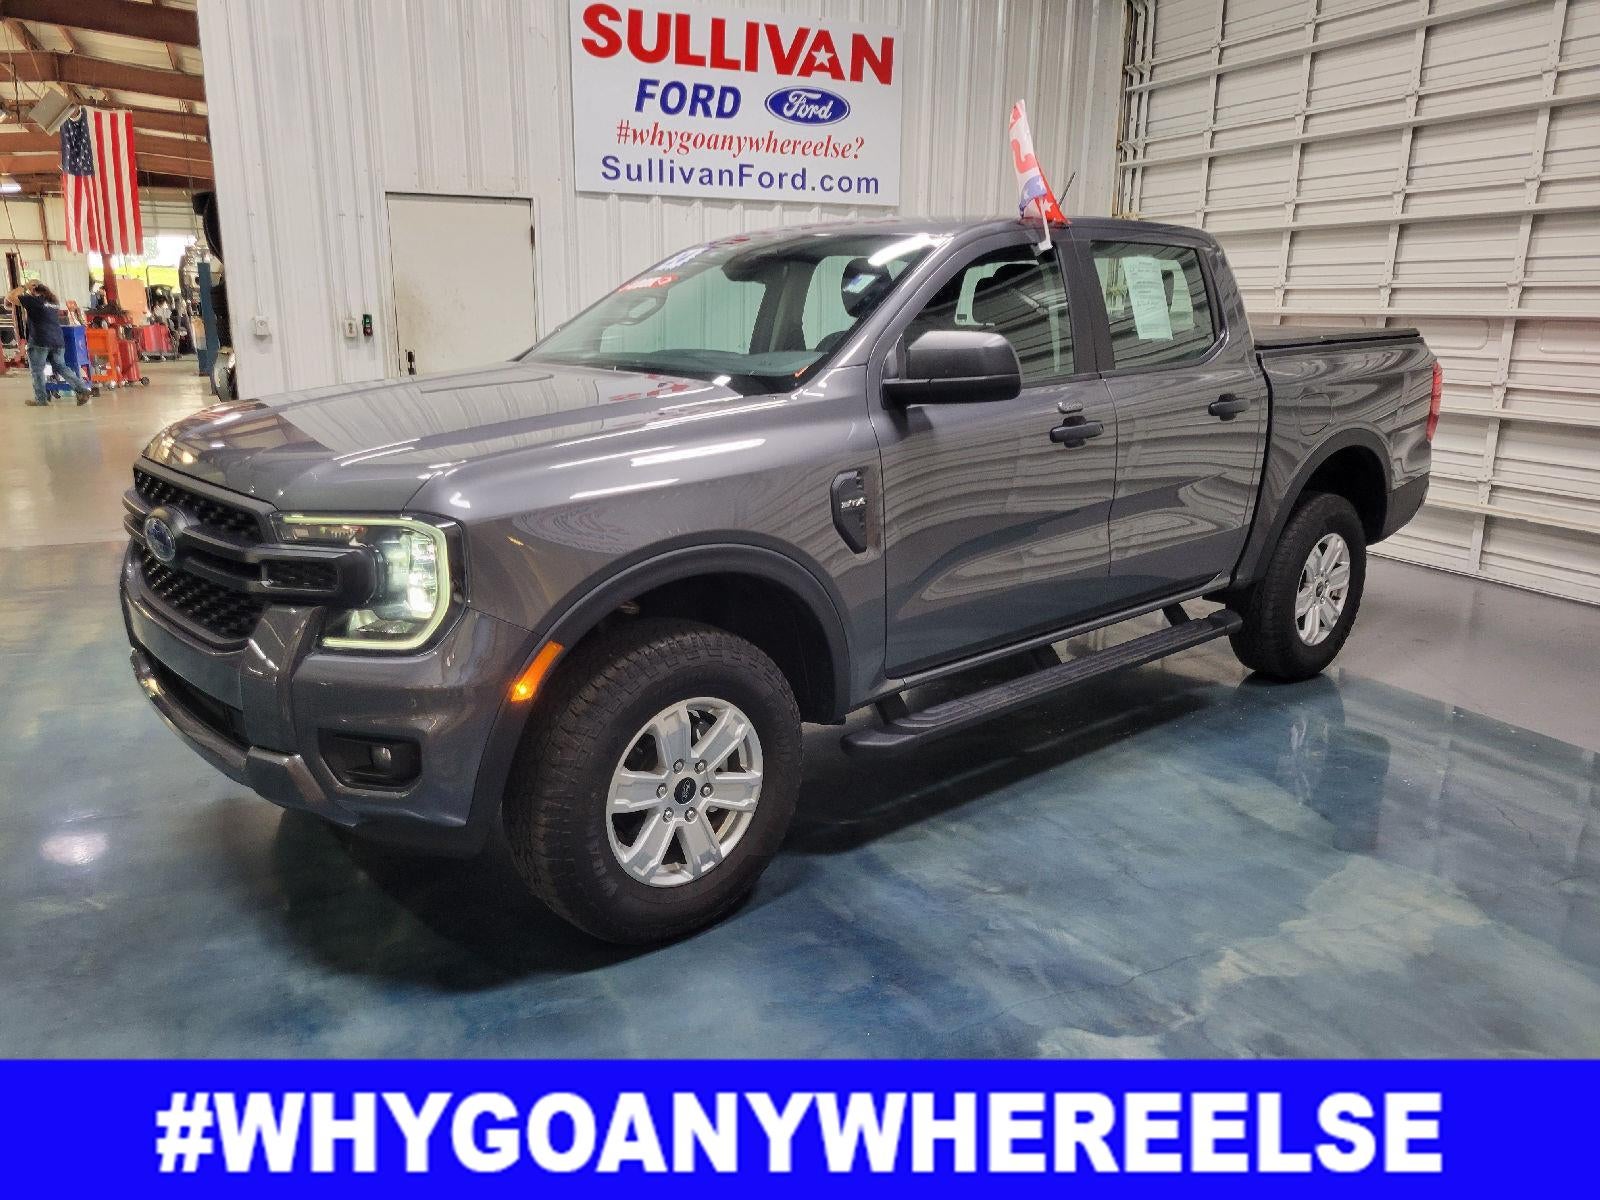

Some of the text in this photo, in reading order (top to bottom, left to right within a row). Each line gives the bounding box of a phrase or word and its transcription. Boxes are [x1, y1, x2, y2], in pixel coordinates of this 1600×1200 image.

[582, 3, 895, 85] SULLIVAN
[634, 78, 741, 119] FORD
[783, 91, 833, 120] Ford
[616, 120, 865, 160] #whygoanywhereelse?
[601, 155, 880, 195] SullivanFord.com
